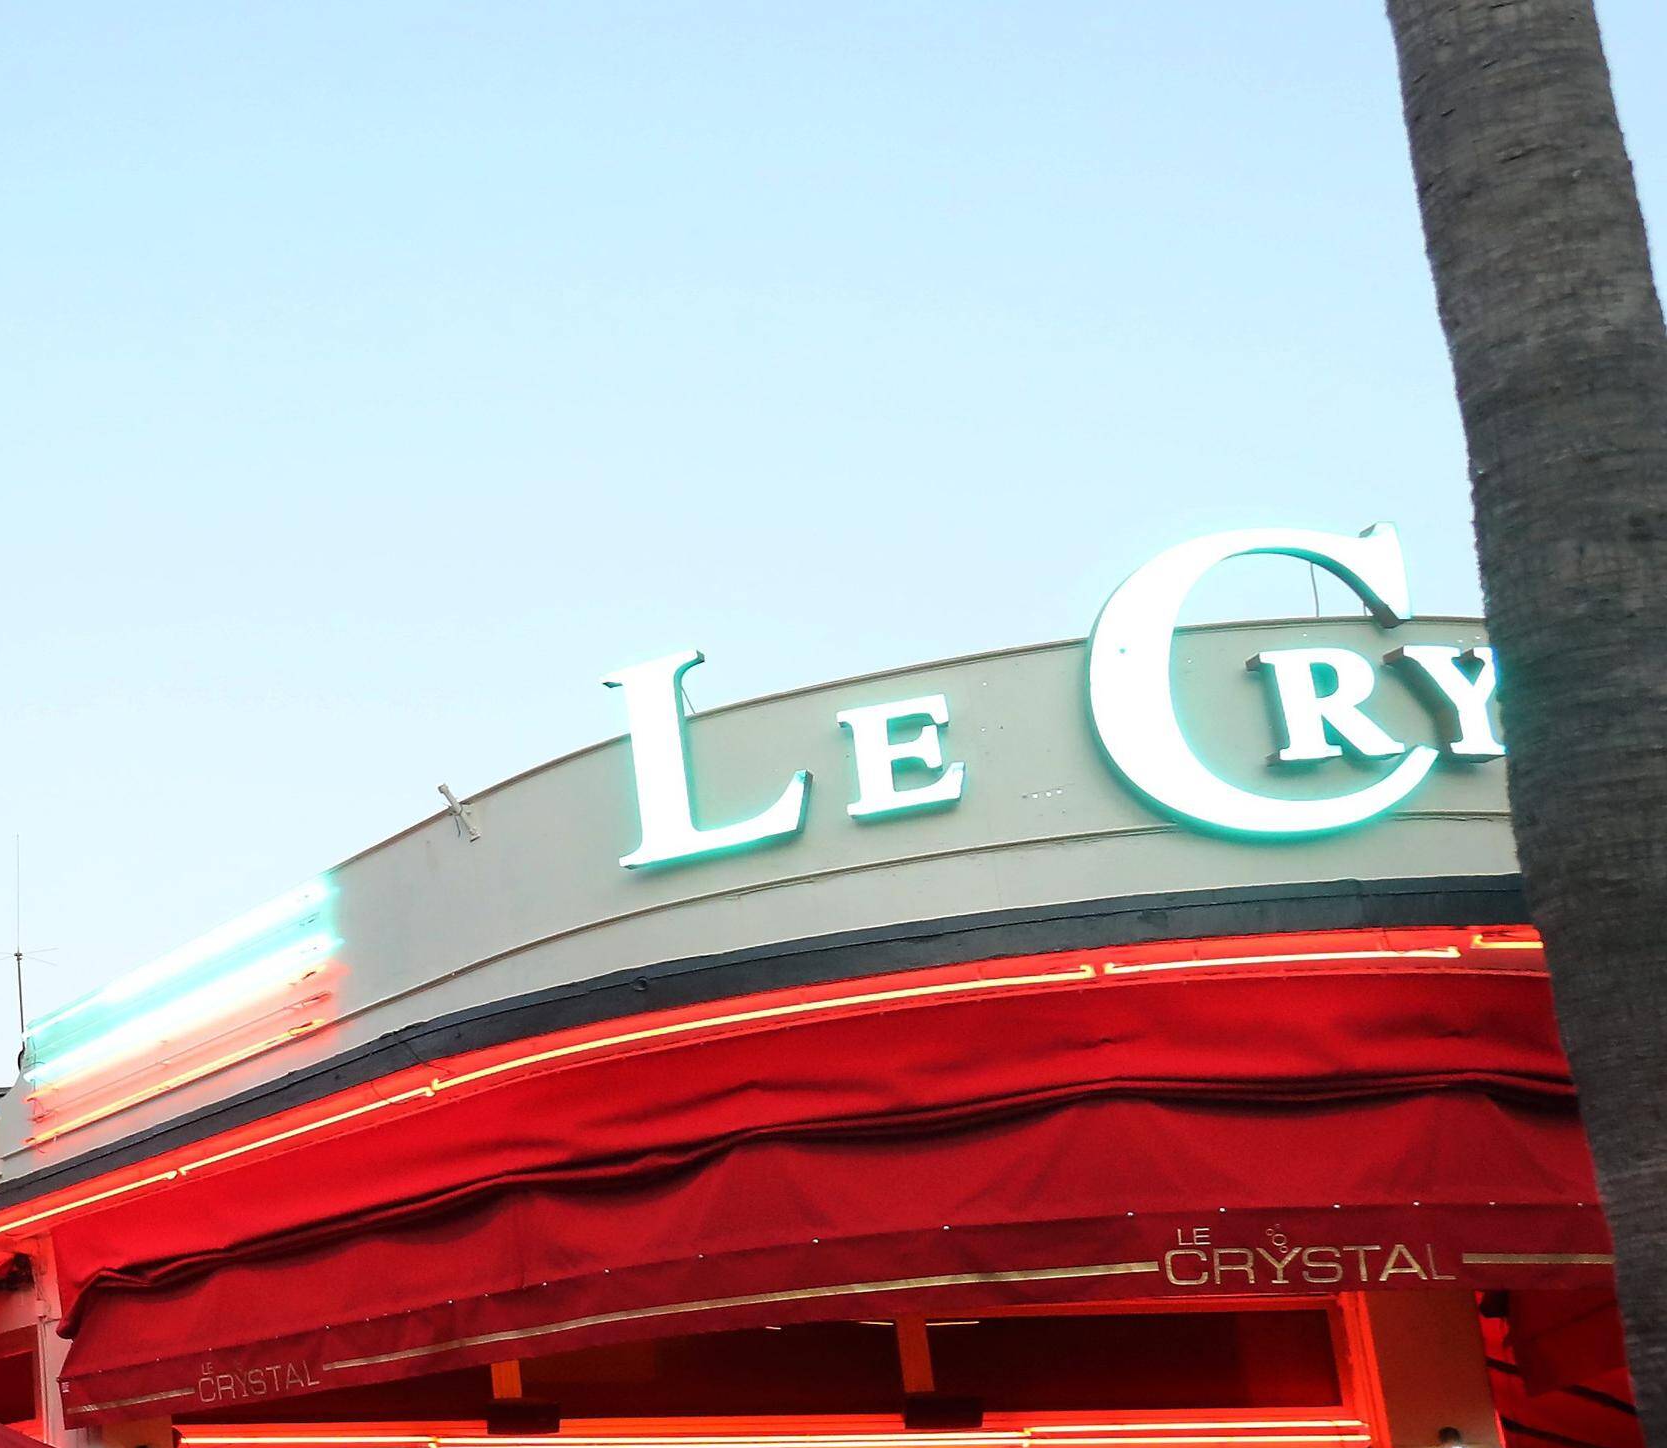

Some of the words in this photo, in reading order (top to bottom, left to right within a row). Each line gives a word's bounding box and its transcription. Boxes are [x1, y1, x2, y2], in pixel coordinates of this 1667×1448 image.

[603, 650, 967, 870] LE
[1177, 1227, 1211, 1246] LE
[1164, 1244, 1458, 1286] CRYSTAL
[198, 1360, 320, 1402] CRYSTAL
